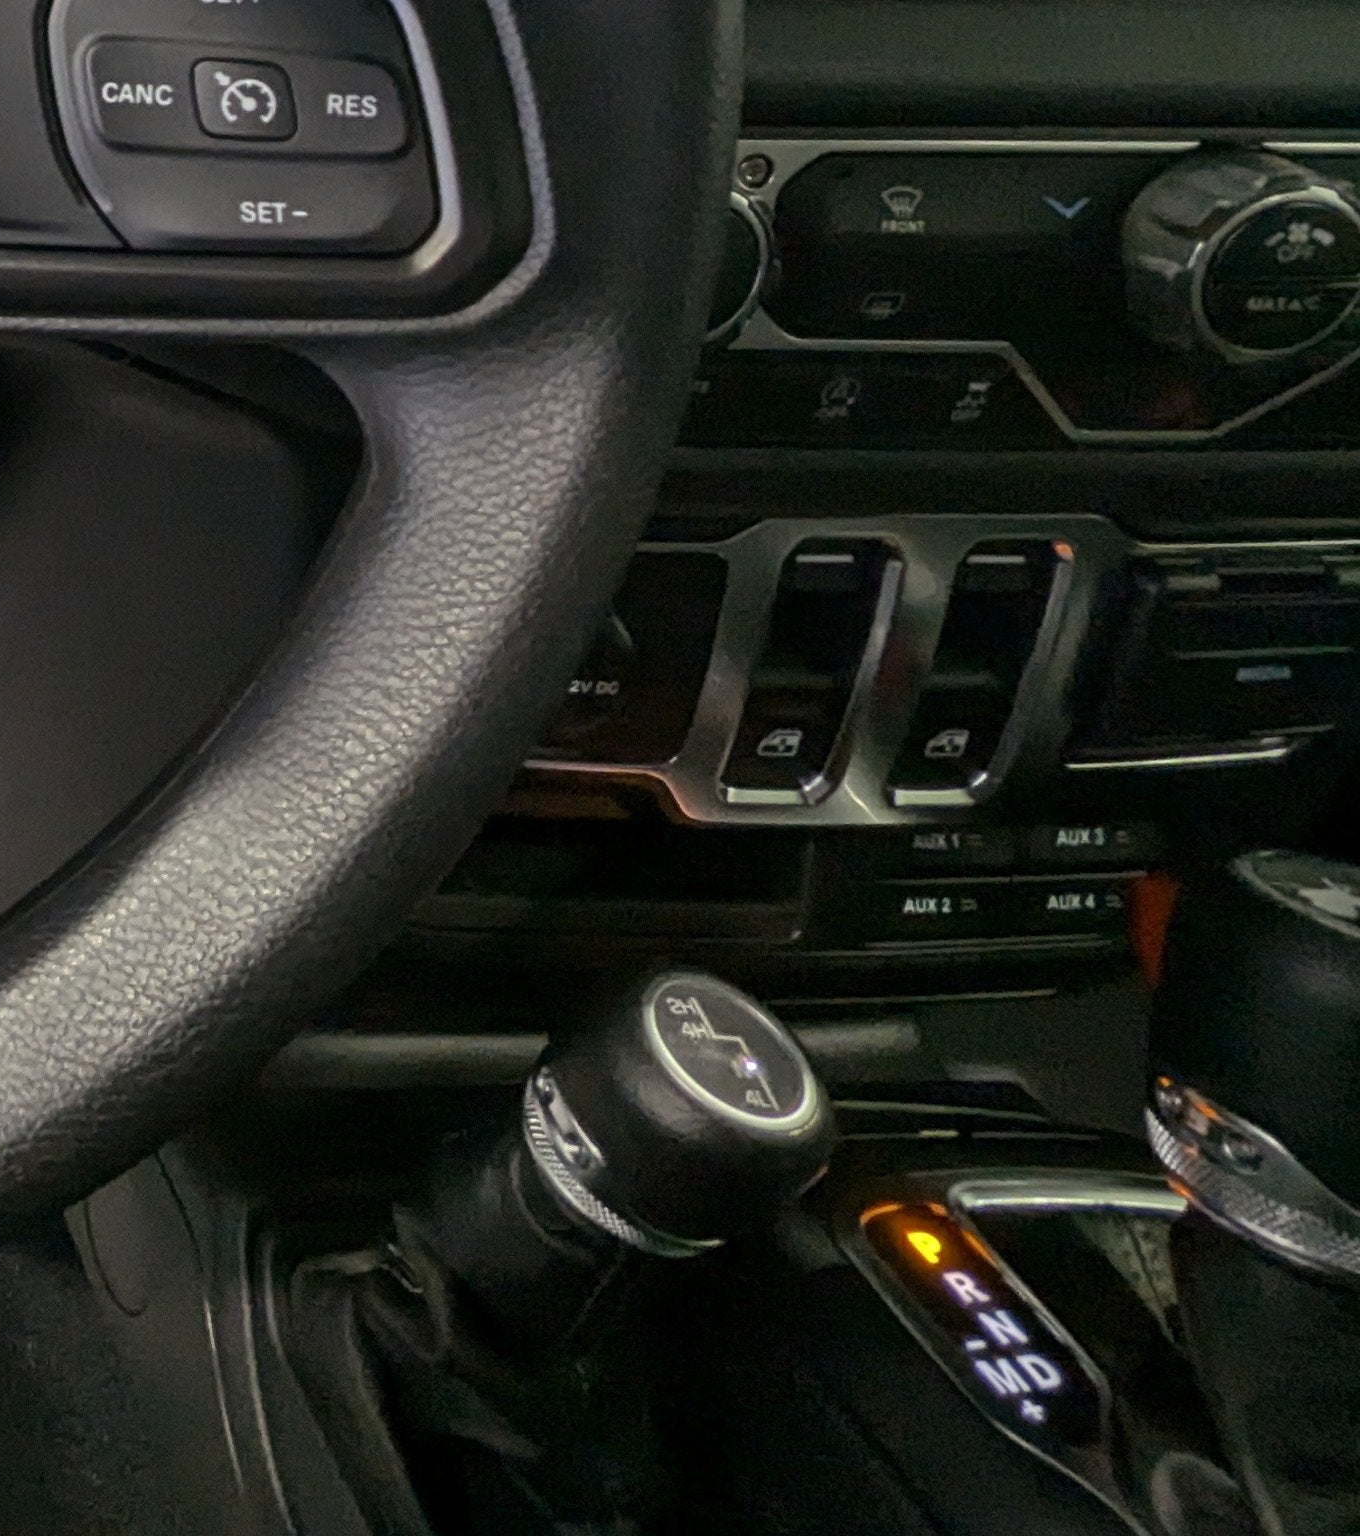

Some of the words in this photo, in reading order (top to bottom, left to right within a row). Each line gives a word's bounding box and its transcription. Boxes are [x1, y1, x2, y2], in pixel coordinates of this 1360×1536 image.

[101, 83, 173, 107] CANC
[327, 94, 378, 118] RES
[951, 833, 960, 849] 1
[1056, 827, 1089, 846] AUX
[1094, 828, 1105, 846] 3
[903, 896, 937, 914] AUX
[942, 897, 952, 914] 2
[1046, 894, 1081, 910] AUX
[1084, 893, 1095, 909] 4
[681, 1021, 711, 1044] 4H
[745, 1089, 772, 1109] 4L
[907, 1232, 942, 1264] P
[942, 1271, 991, 1304] R
[978, 1309, 1029, 1346] N
[974, 1357, 1030, 1395] M
[1016, 1354, 1062, 1390] D
